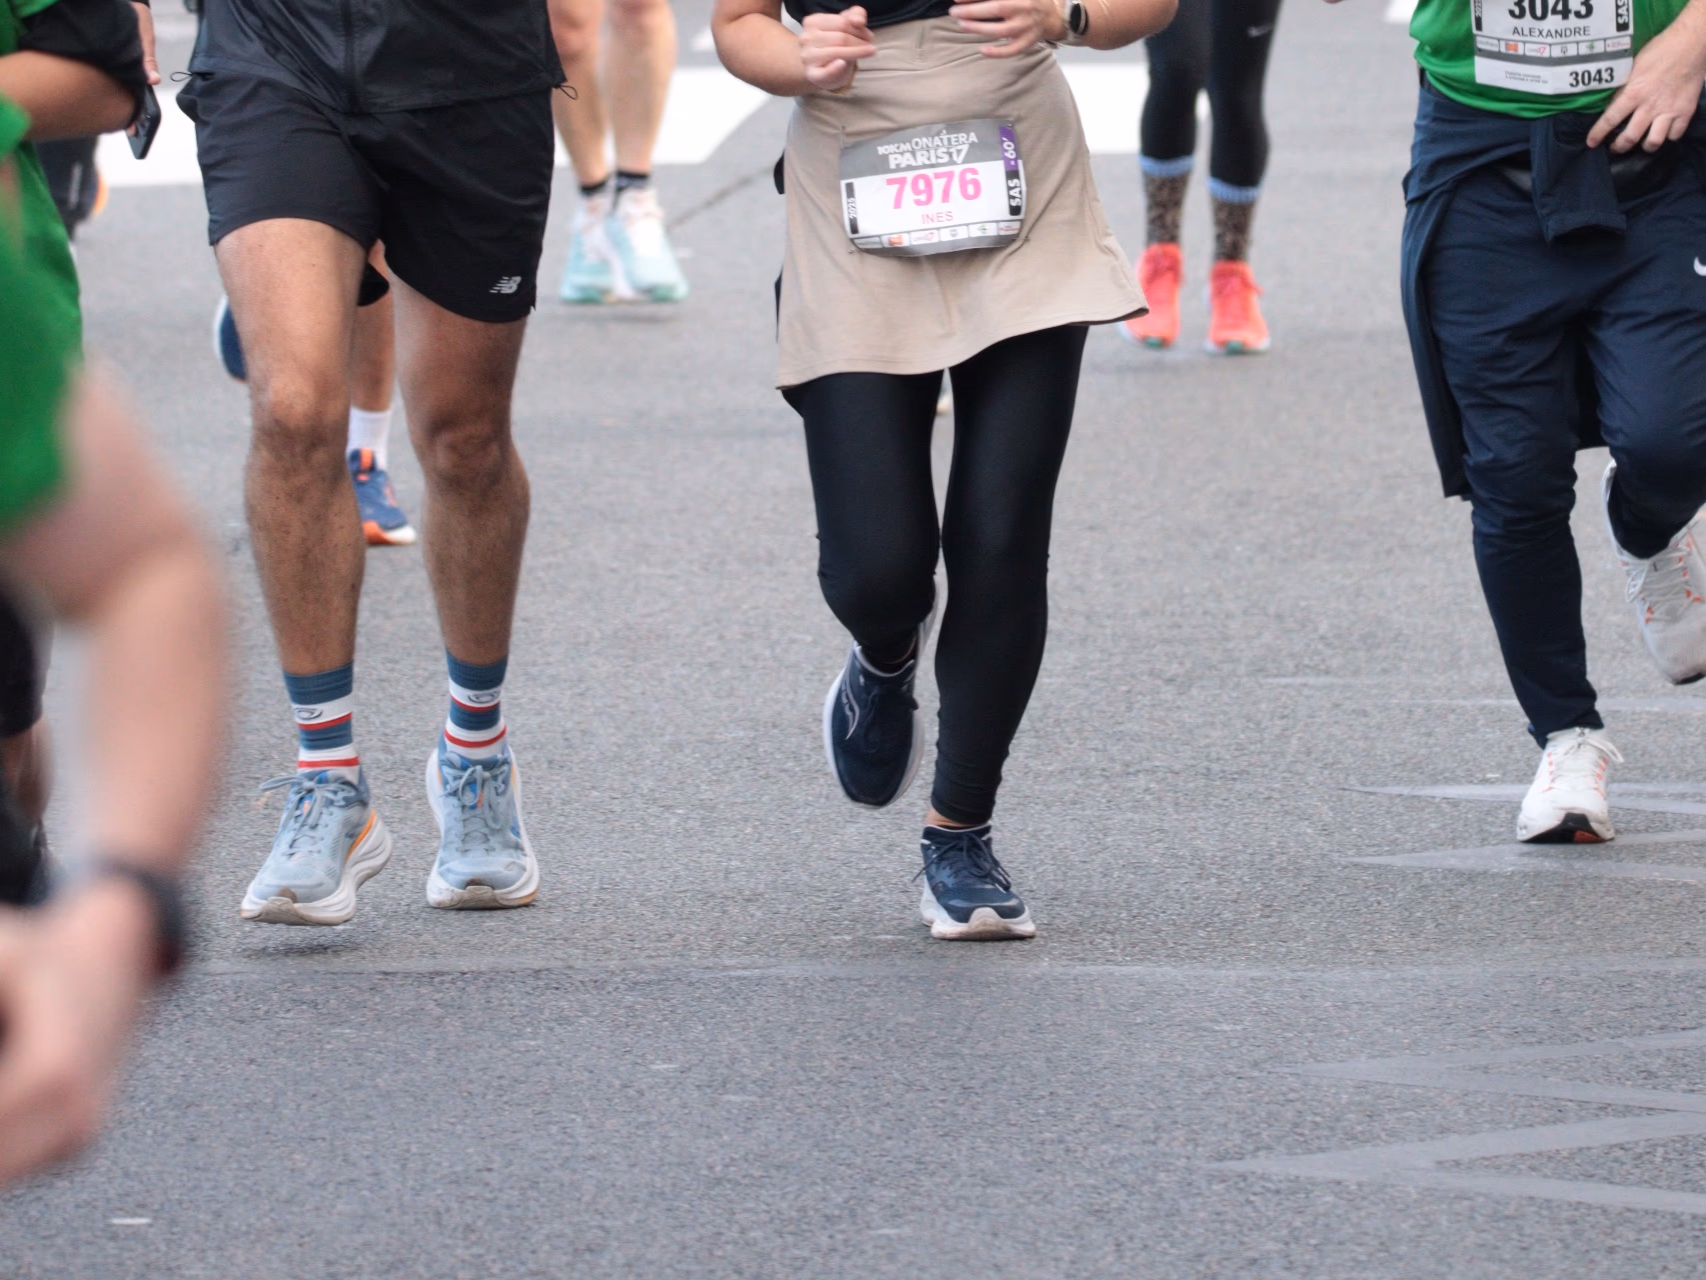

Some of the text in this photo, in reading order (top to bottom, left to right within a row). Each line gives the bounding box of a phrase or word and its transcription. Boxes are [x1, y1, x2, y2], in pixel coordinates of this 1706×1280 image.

[1512, 26, 1591, 39] ALEXANDRE
[1569, 66, 1615, 88] 3043
[885, 167, 982, 210] 7976
[1008, 178, 1022, 207] SAS
[921, 211, 954, 225] INES
